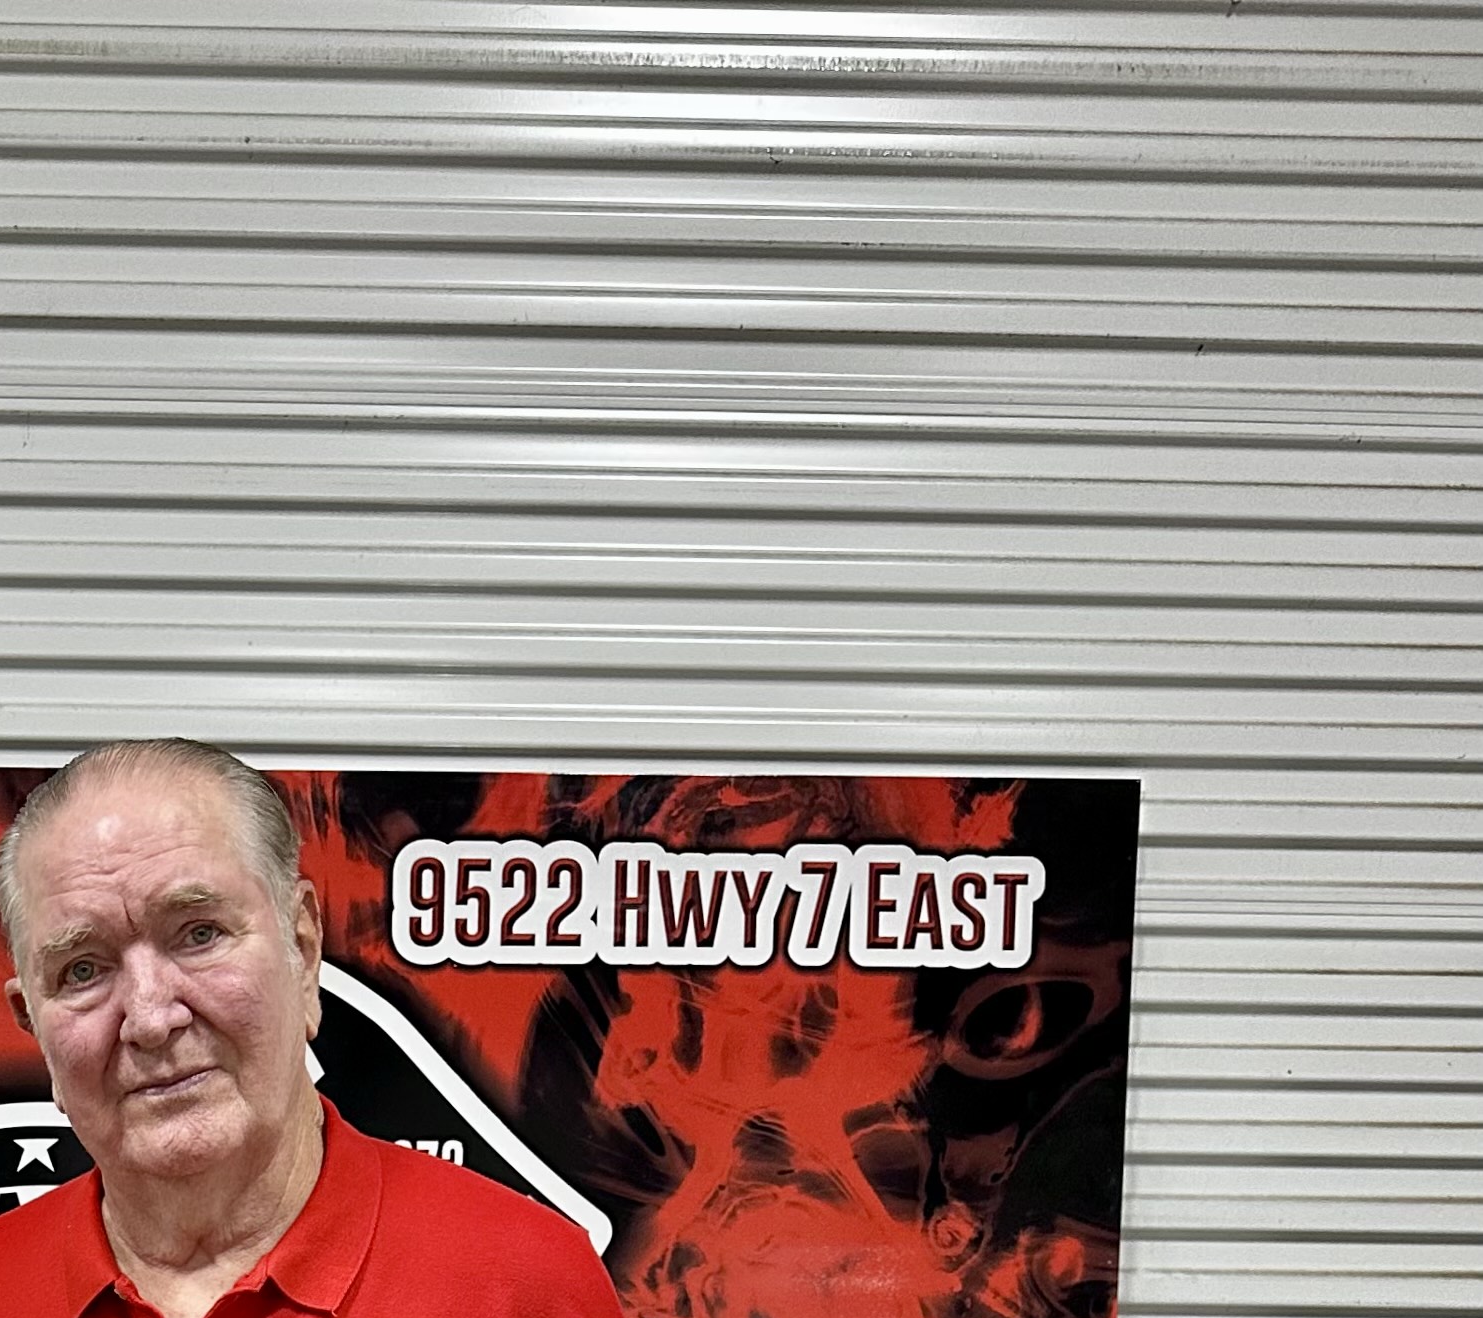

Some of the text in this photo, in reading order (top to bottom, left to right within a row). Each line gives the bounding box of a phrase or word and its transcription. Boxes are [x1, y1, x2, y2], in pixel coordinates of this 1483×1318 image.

[409, 856, 1029, 951] 9522 HWY 7 EAST
